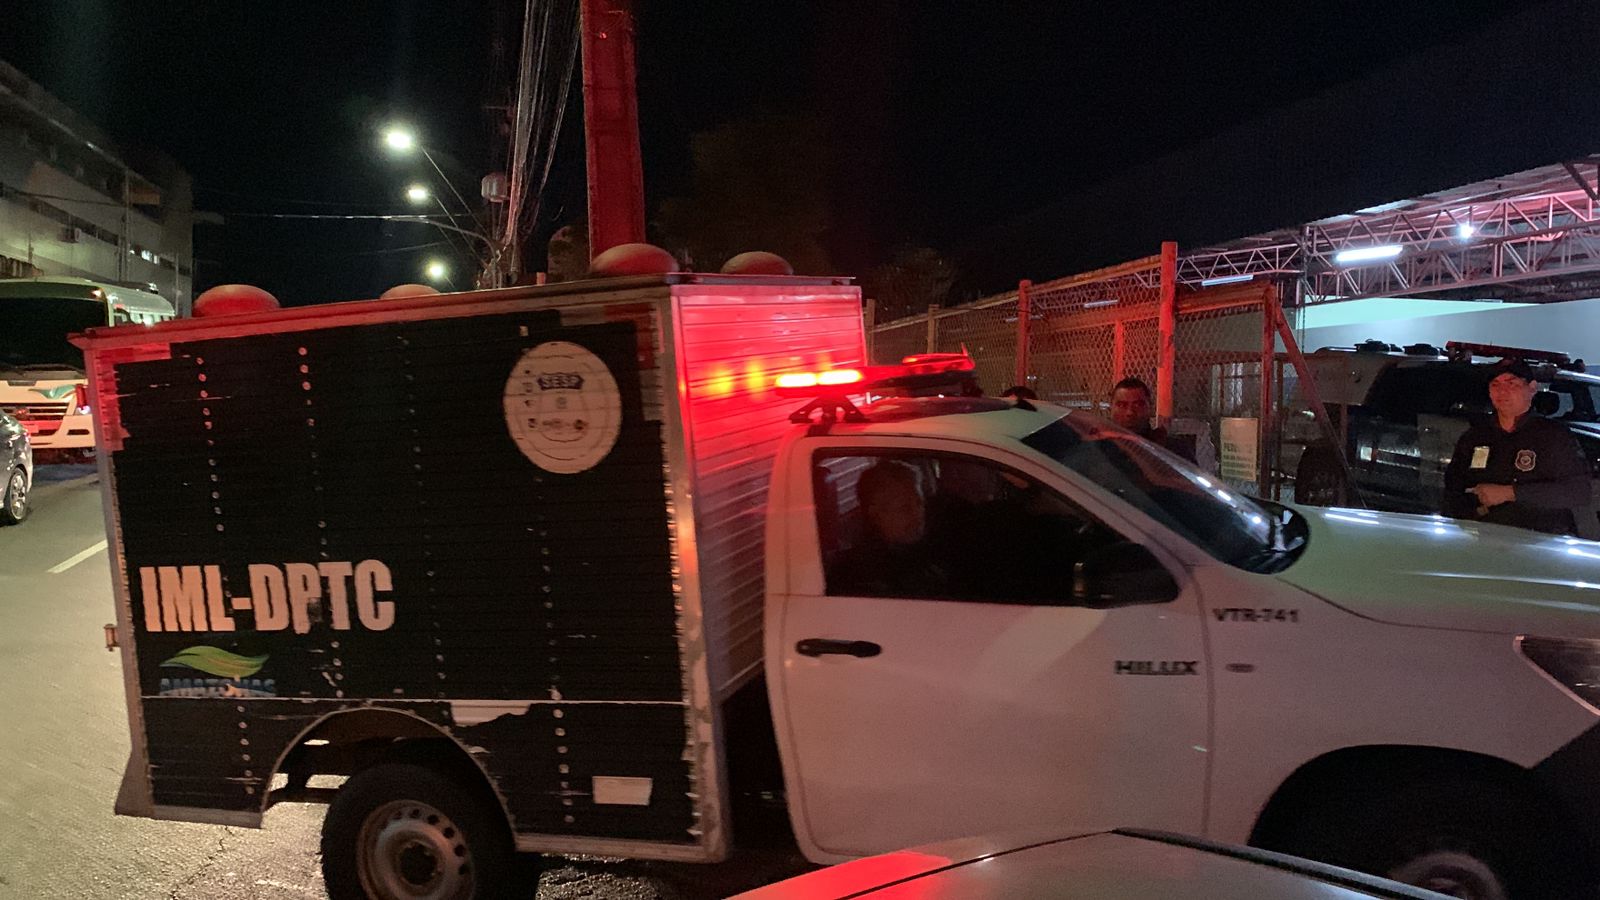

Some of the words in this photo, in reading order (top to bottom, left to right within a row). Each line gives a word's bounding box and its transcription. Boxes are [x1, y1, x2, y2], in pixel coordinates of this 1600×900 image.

[140, 560, 395, 634] IML-DPTC
[1213, 608, 1299, 622] VTR-741
[1115, 660, 1199, 675] HILUX
